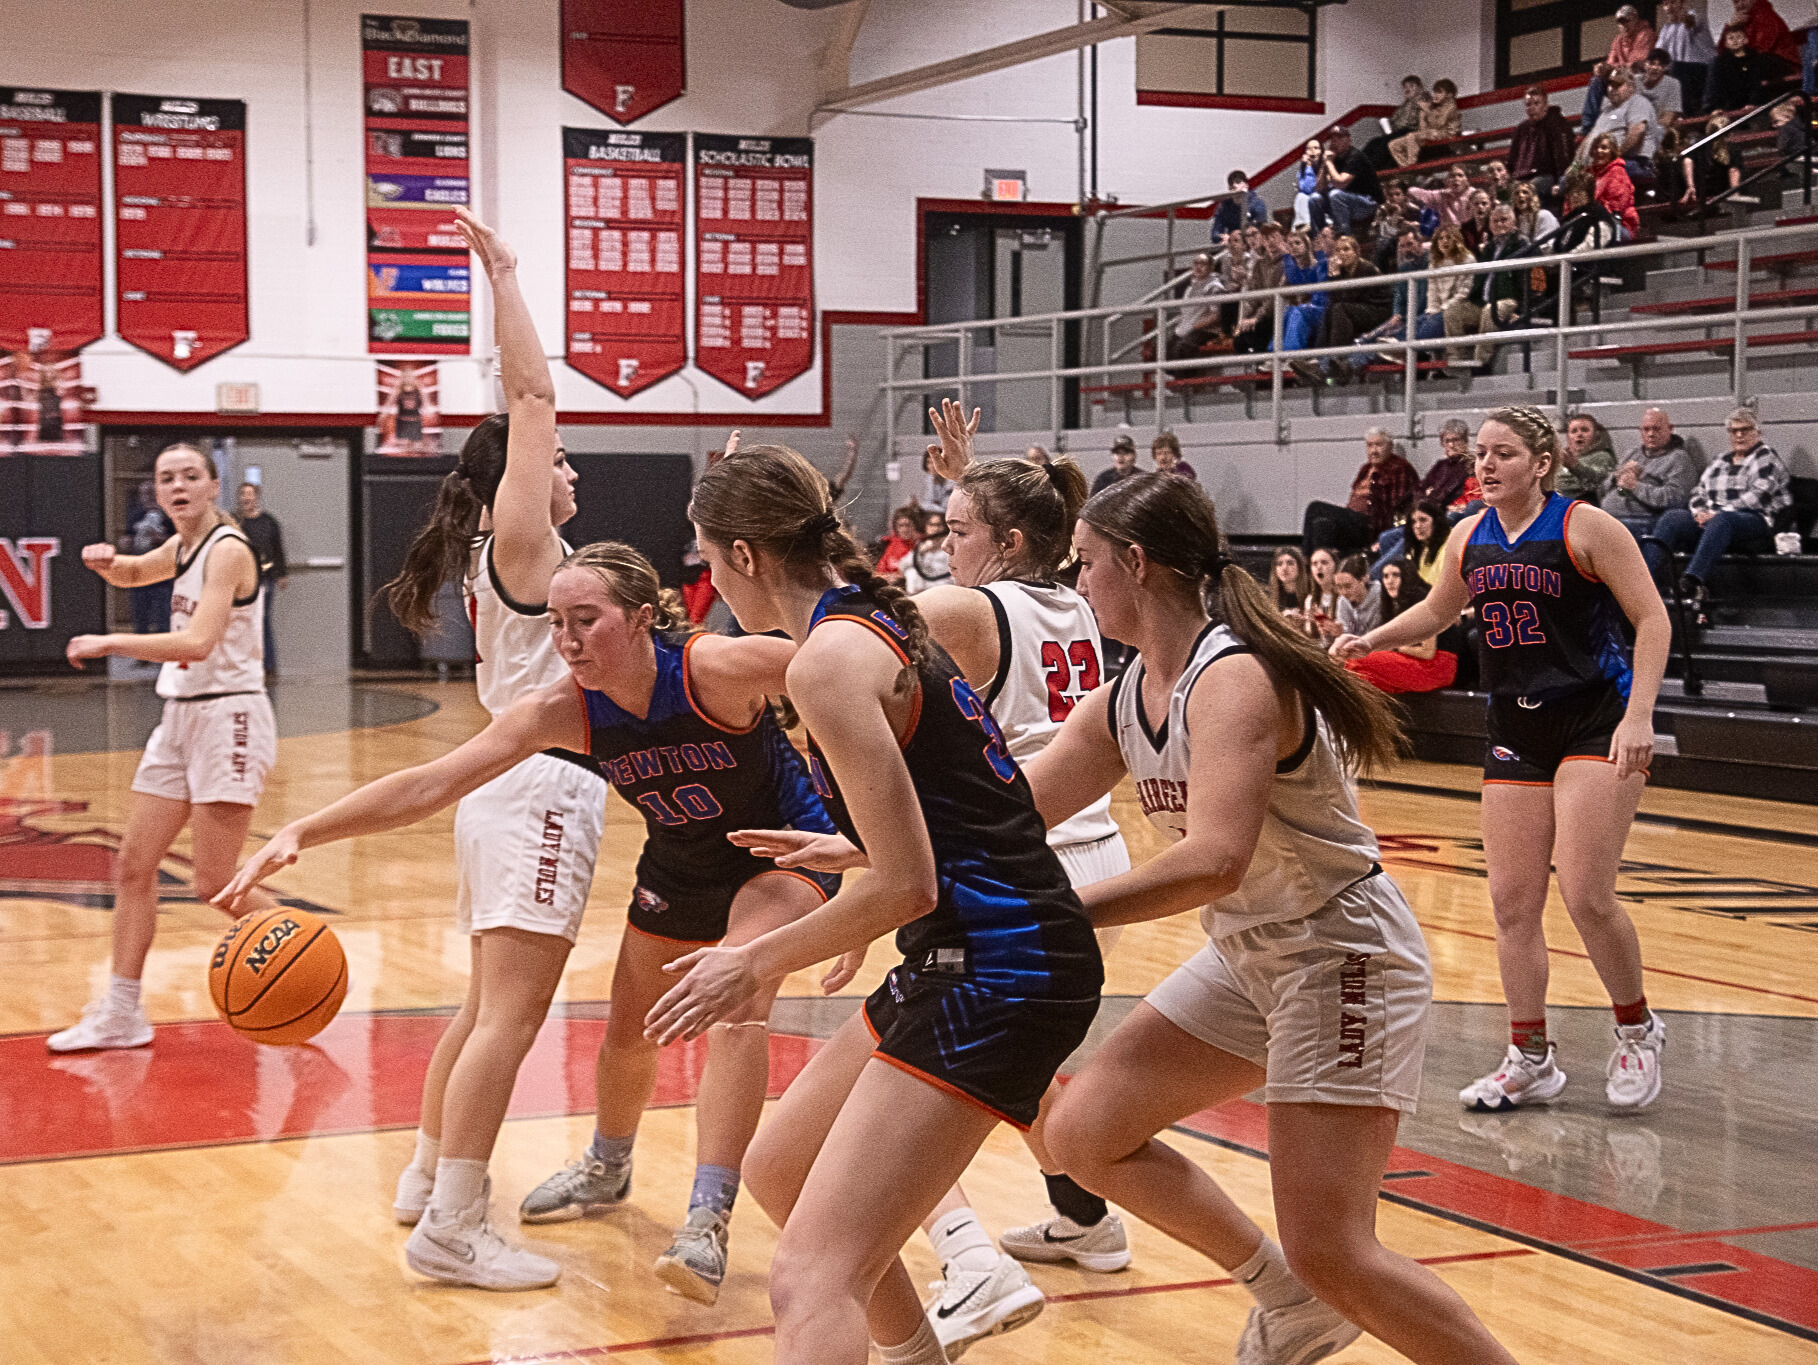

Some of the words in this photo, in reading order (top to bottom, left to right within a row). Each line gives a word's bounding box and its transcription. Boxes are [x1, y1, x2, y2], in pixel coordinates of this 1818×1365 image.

[387, 56, 443, 80] EAST
[615, 85, 635, 112] F
[588, 145, 661, 162] BASKETBALL
[617, 358, 640, 386] F
[745, 361, 766, 388] F
[1467, 563, 1561, 598] NEWTON
[1482, 600, 1546, 649] 32
[599, 741, 737, 785] NEWTON
[637, 783, 723, 826] 10
[541, 810, 563, 854] LADY
[535, 856, 559, 906] MULES
[244, 919, 300, 975] NCAA
[1340, 953, 1372, 1006] MULES
[1337, 1012, 1367, 1069] LADY
